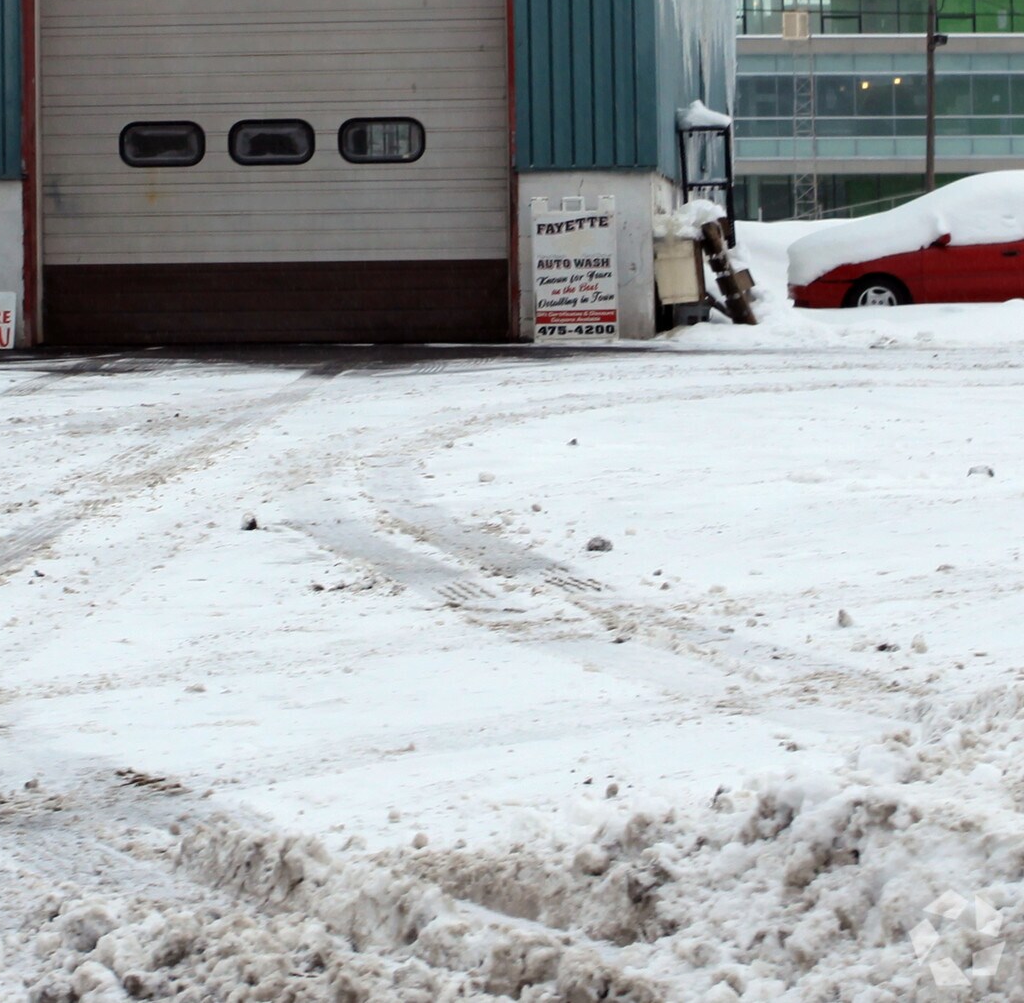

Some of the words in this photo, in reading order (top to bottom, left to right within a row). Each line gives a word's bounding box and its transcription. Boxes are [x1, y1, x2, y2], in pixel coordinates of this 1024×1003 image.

[537, 216, 609, 235] FAYETTE
[537, 258, 571, 269] AUTO
[573, 257, 611, 268] WASH
[563, 285, 577, 294] the
[537, 324, 616, 336] 475-4200
